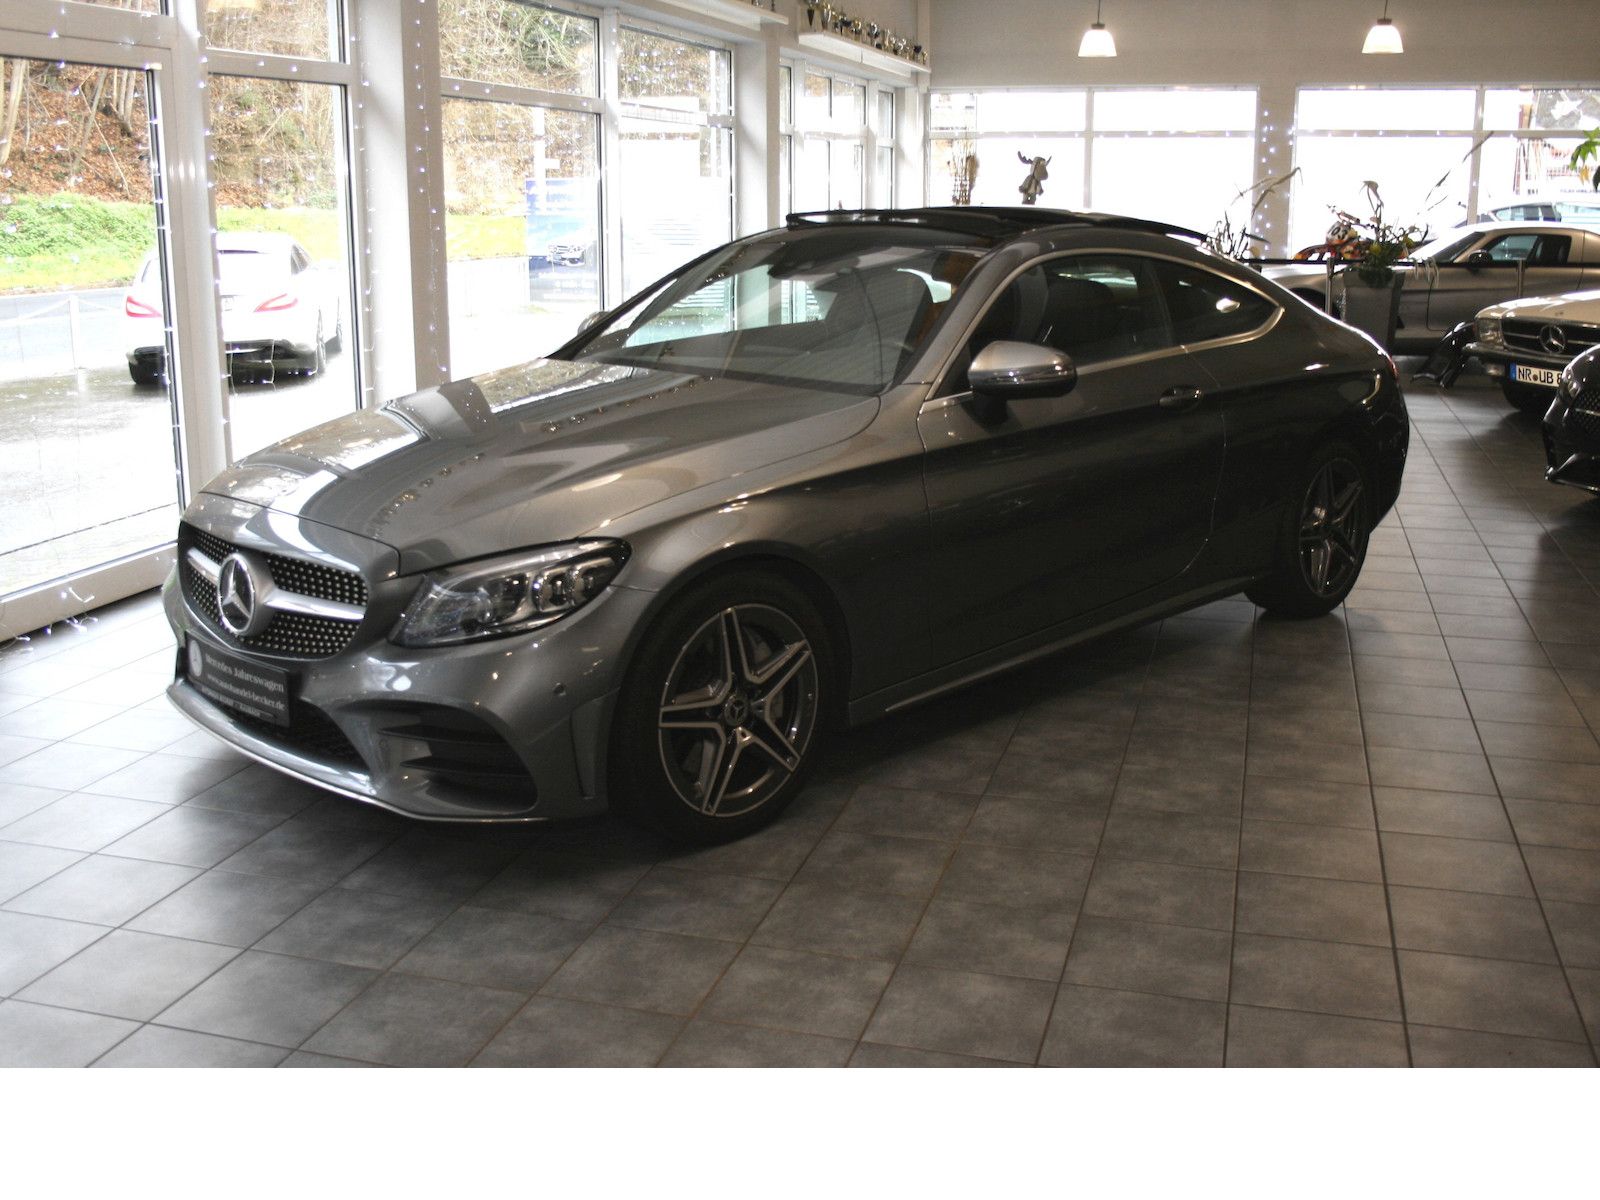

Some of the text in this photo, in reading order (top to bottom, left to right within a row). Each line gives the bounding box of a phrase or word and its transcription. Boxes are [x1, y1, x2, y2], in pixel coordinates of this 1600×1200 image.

[1518, 367, 1532, 381] NR
[1539, 371, 1554, 384] UB
[234, 667, 284, 693] Jahreswagen
